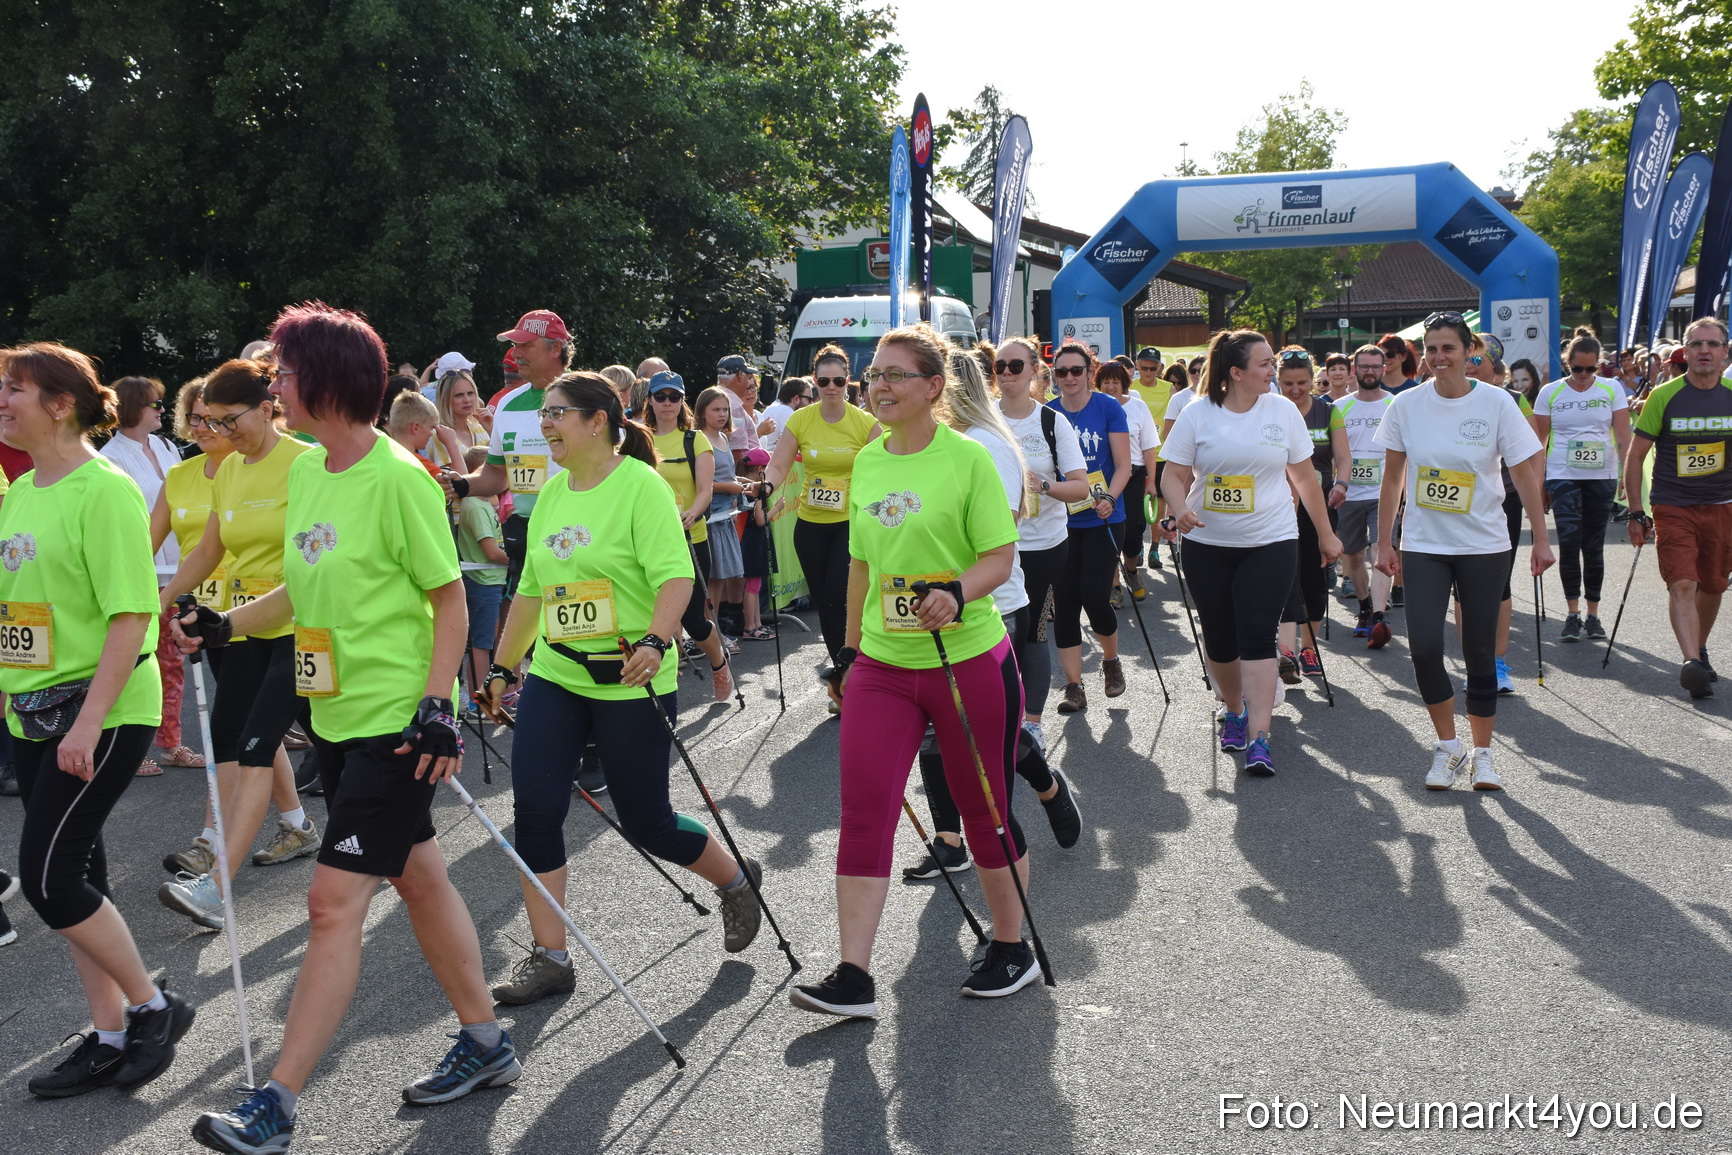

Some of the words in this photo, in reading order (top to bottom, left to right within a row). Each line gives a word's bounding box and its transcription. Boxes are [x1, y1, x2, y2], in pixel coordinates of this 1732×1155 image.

[1640, 104, 1666, 192] Fischer
[1650, 114, 1670, 187] AUTOMOBILE
[1290, 194, 1320, 202] Fischer
[1674, 173, 1698, 230] Fischer
[1682, 180, 1701, 228] AUTOMOBILE
[1268, 206, 1357, 227] firmenlauf
[1451, 231, 1464, 239] und
[1466, 228, 1479, 236] das
[1488, 233, 1506, 241] mit!
[1102, 247, 1149, 259] Fischer
[522, 319, 550, 337] FIAT
[803, 318, 840, 328] abavent
[1556, 399, 1608, 412] gangart
[1671, 417, 1732, 431] BOCK
[1575, 450, 1598, 461] 923
[1688, 454, 1715, 468] 295
[513, 468, 536, 483] 117
[1352, 467, 1373, 478] 925
[811, 488, 840, 503] 1223
[1213, 488, 1242, 503] 683
[1426, 482, 1460, 501] 692
[196, 580, 218, 597] 14
[557, 601, 597, 626] 670
[0, 625, 34, 651] 669
[15, 651, 36, 659] Andrea
[296, 651, 317, 678] 65
[299, 678, 312, 686] Anita
[334, 844, 364, 856] adidas
